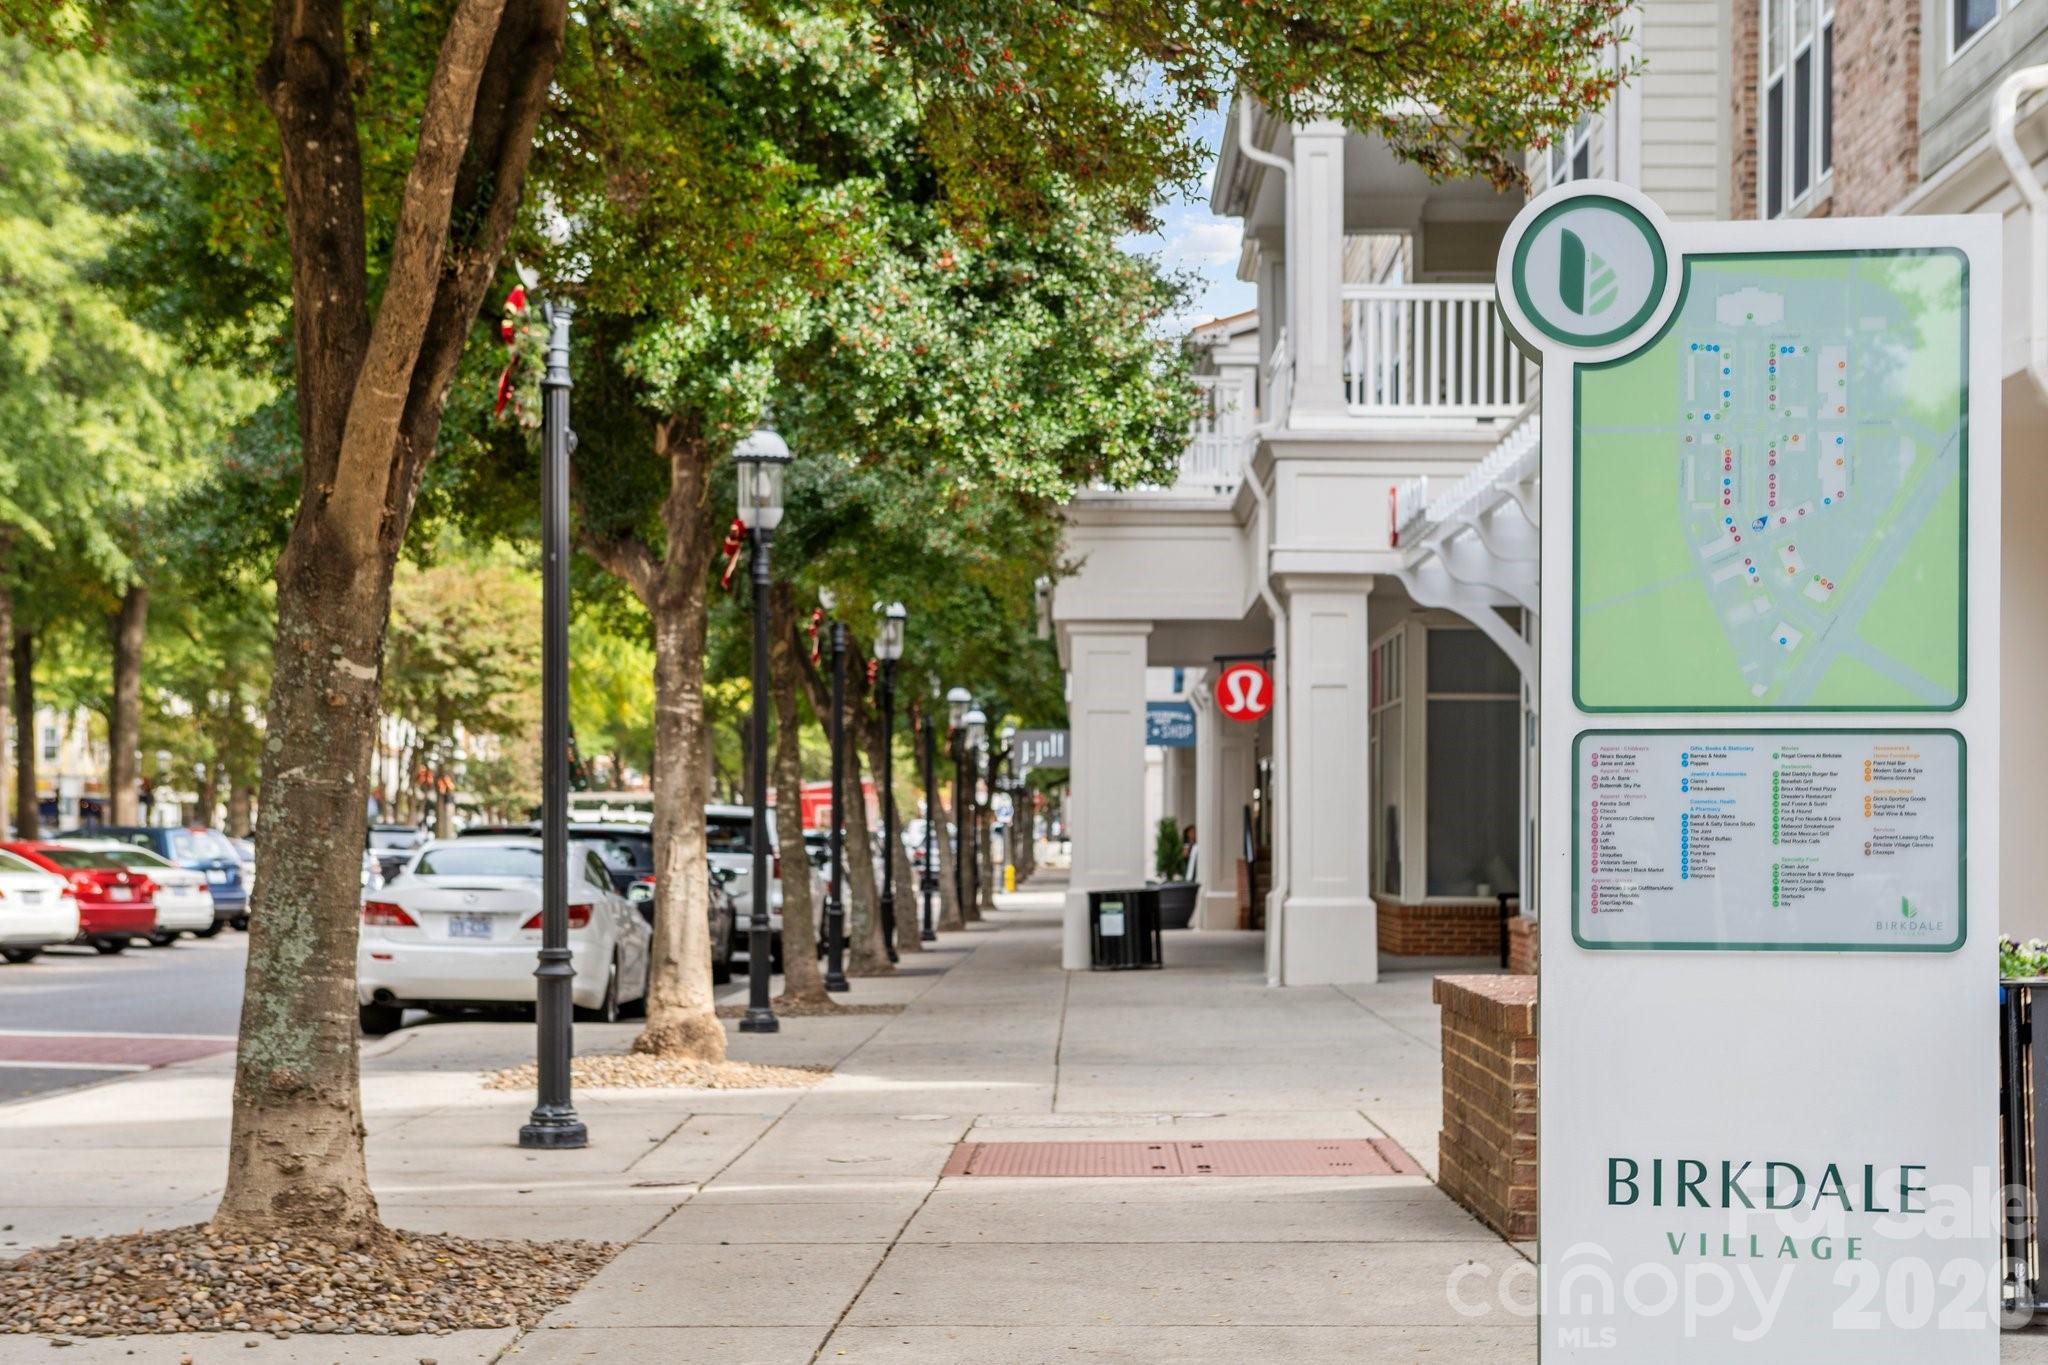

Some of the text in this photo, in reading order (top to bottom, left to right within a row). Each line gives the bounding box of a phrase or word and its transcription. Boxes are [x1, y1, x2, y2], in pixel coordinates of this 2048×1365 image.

[1876, 922, 1943, 930] BIRKDALE
[1608, 1157, 1926, 1213] BIRKDALE
[1666, 1232, 1862, 1260] VILLAGE
